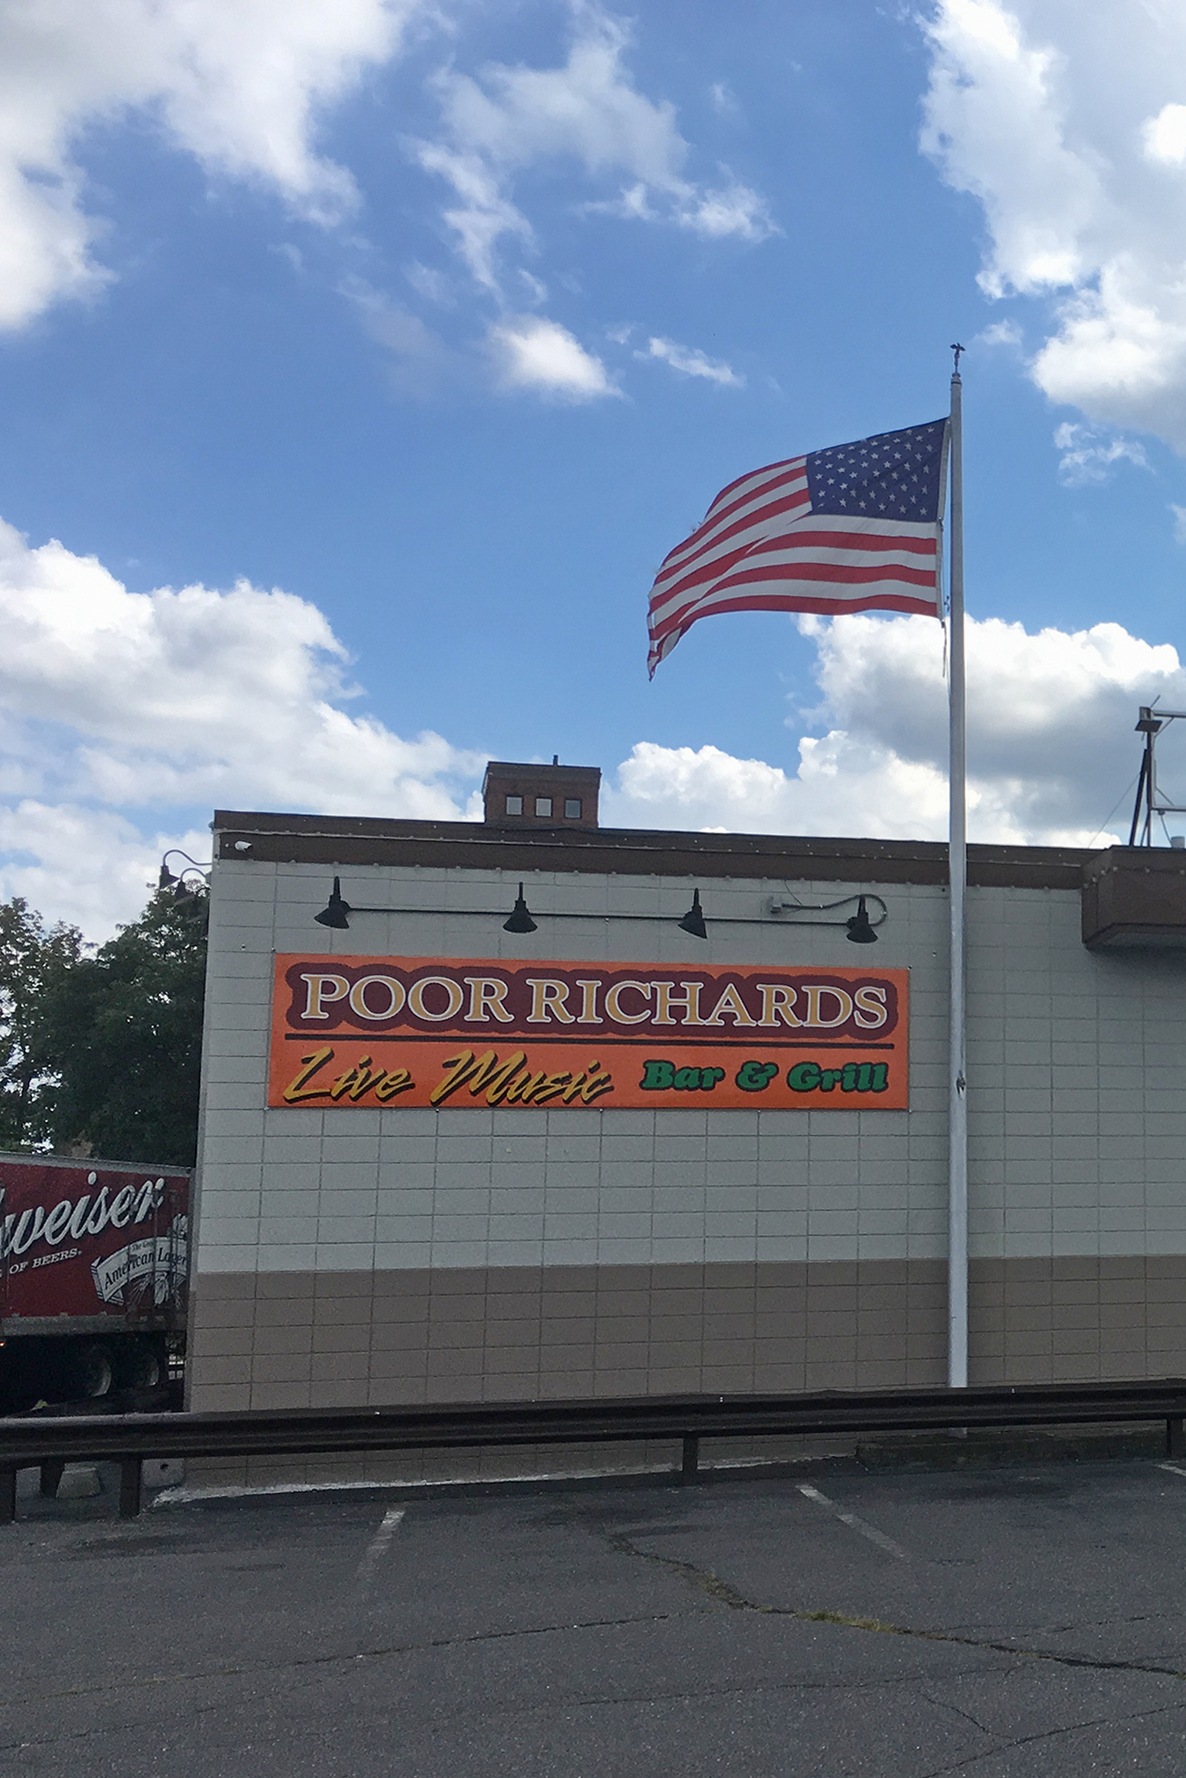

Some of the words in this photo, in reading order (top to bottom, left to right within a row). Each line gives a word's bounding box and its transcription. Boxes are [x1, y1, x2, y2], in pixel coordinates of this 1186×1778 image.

[300, 972, 514, 1022] POOR
[527, 977, 888, 1030] RICHARDS
[283, 1047, 416, 1104] Live
[429, 1049, 616, 1105] Music
[640, 1061, 724, 1091] Bar
[736, 1064, 778, 1092] &
[787, 1062, 888, 1093] Grill
[0, 1172, 165, 1258] weiser
[9, 1260, 29, 1274] OF
